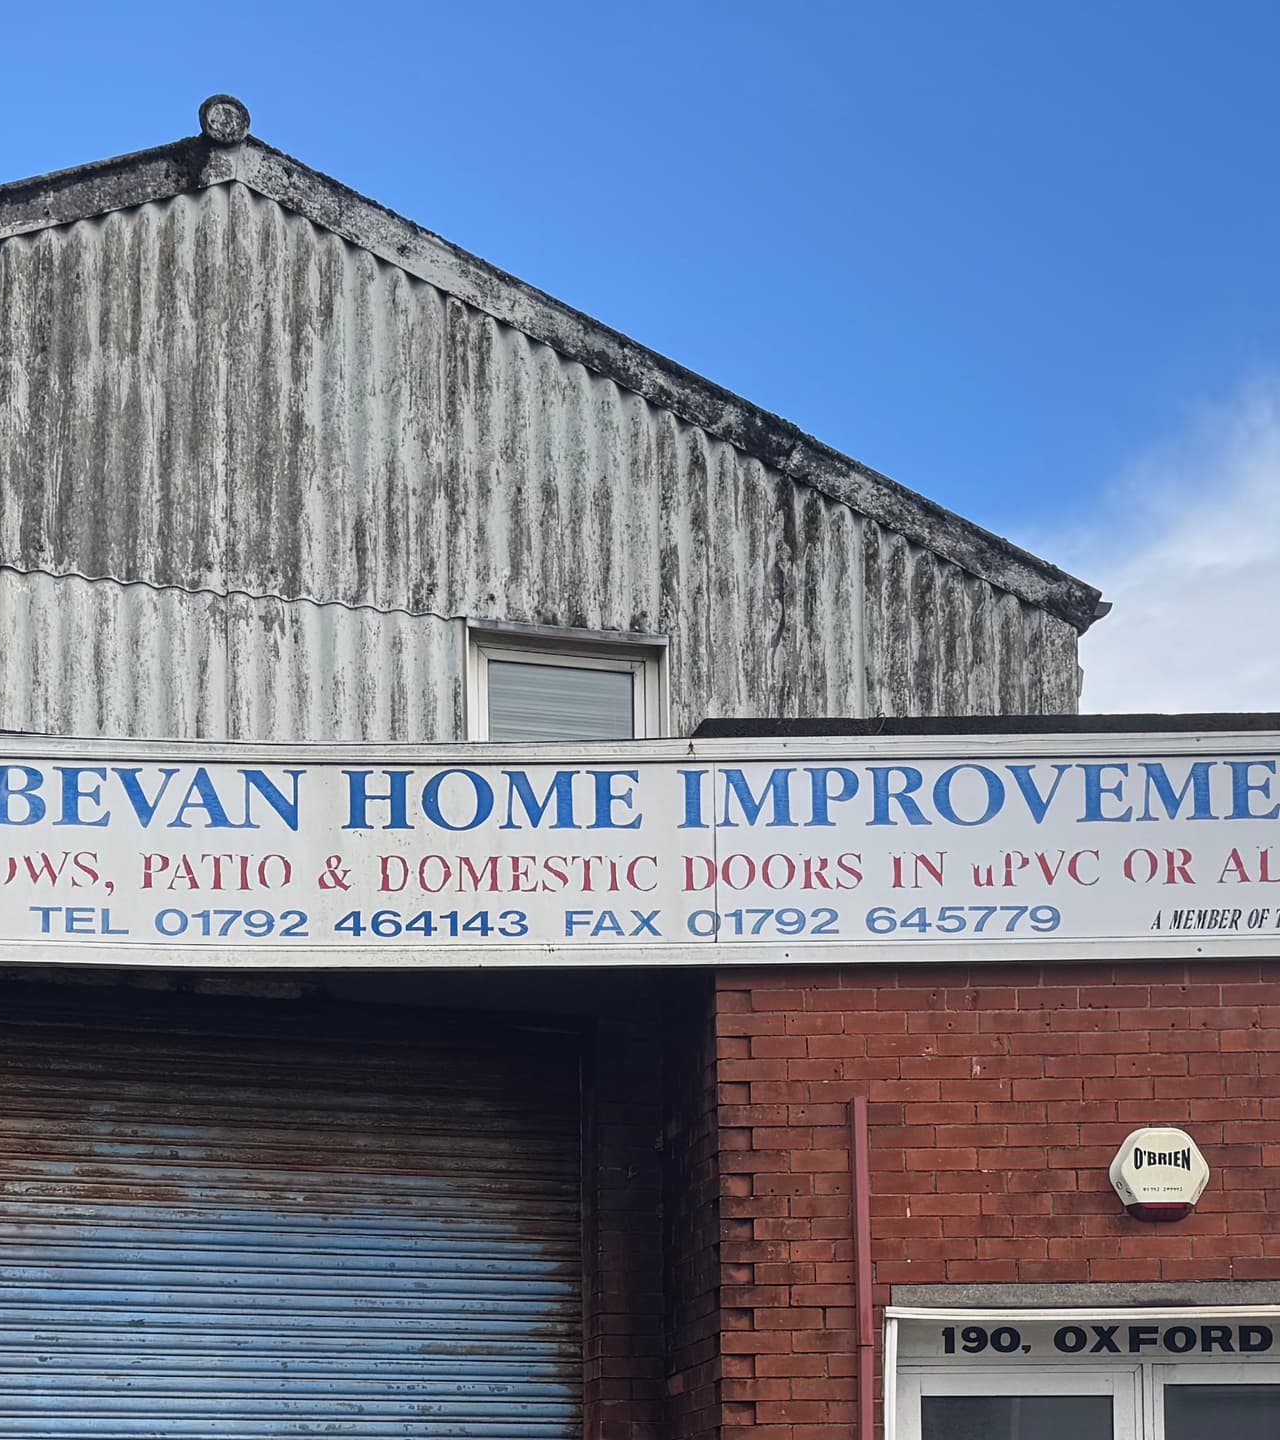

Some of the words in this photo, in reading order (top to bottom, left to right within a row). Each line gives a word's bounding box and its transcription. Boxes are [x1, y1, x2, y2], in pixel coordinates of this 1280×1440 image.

[341, 768, 642, 832] HOME
[139, 851, 293, 891] PATIO
[318, 854, 352, 892] &
[377, 854, 659, 893] DOMESTIC
[681, 852, 864, 892] DOORS
[890, 851, 949, 889] IN
[971, 848, 1101, 888] uPVC
[1123, 847, 1197, 885] OR
[29, 905, 129, 936] TEL
[154, 908, 309, 938] 01792
[334, 909, 529, 938] 464143
[564, 909, 663, 938] FAX
[686, 907, 840, 938] 01792
[865, 904, 1062, 934] 645779
[1150, 908, 1162, 931] A
[1168, 907, 1241, 931] MEMBER
[1247, 907, 1270, 930] OF
[1134, 1147, 1191, 1171] O'BRIEN
[1053, 1325, 1274, 1354] OXFORD
